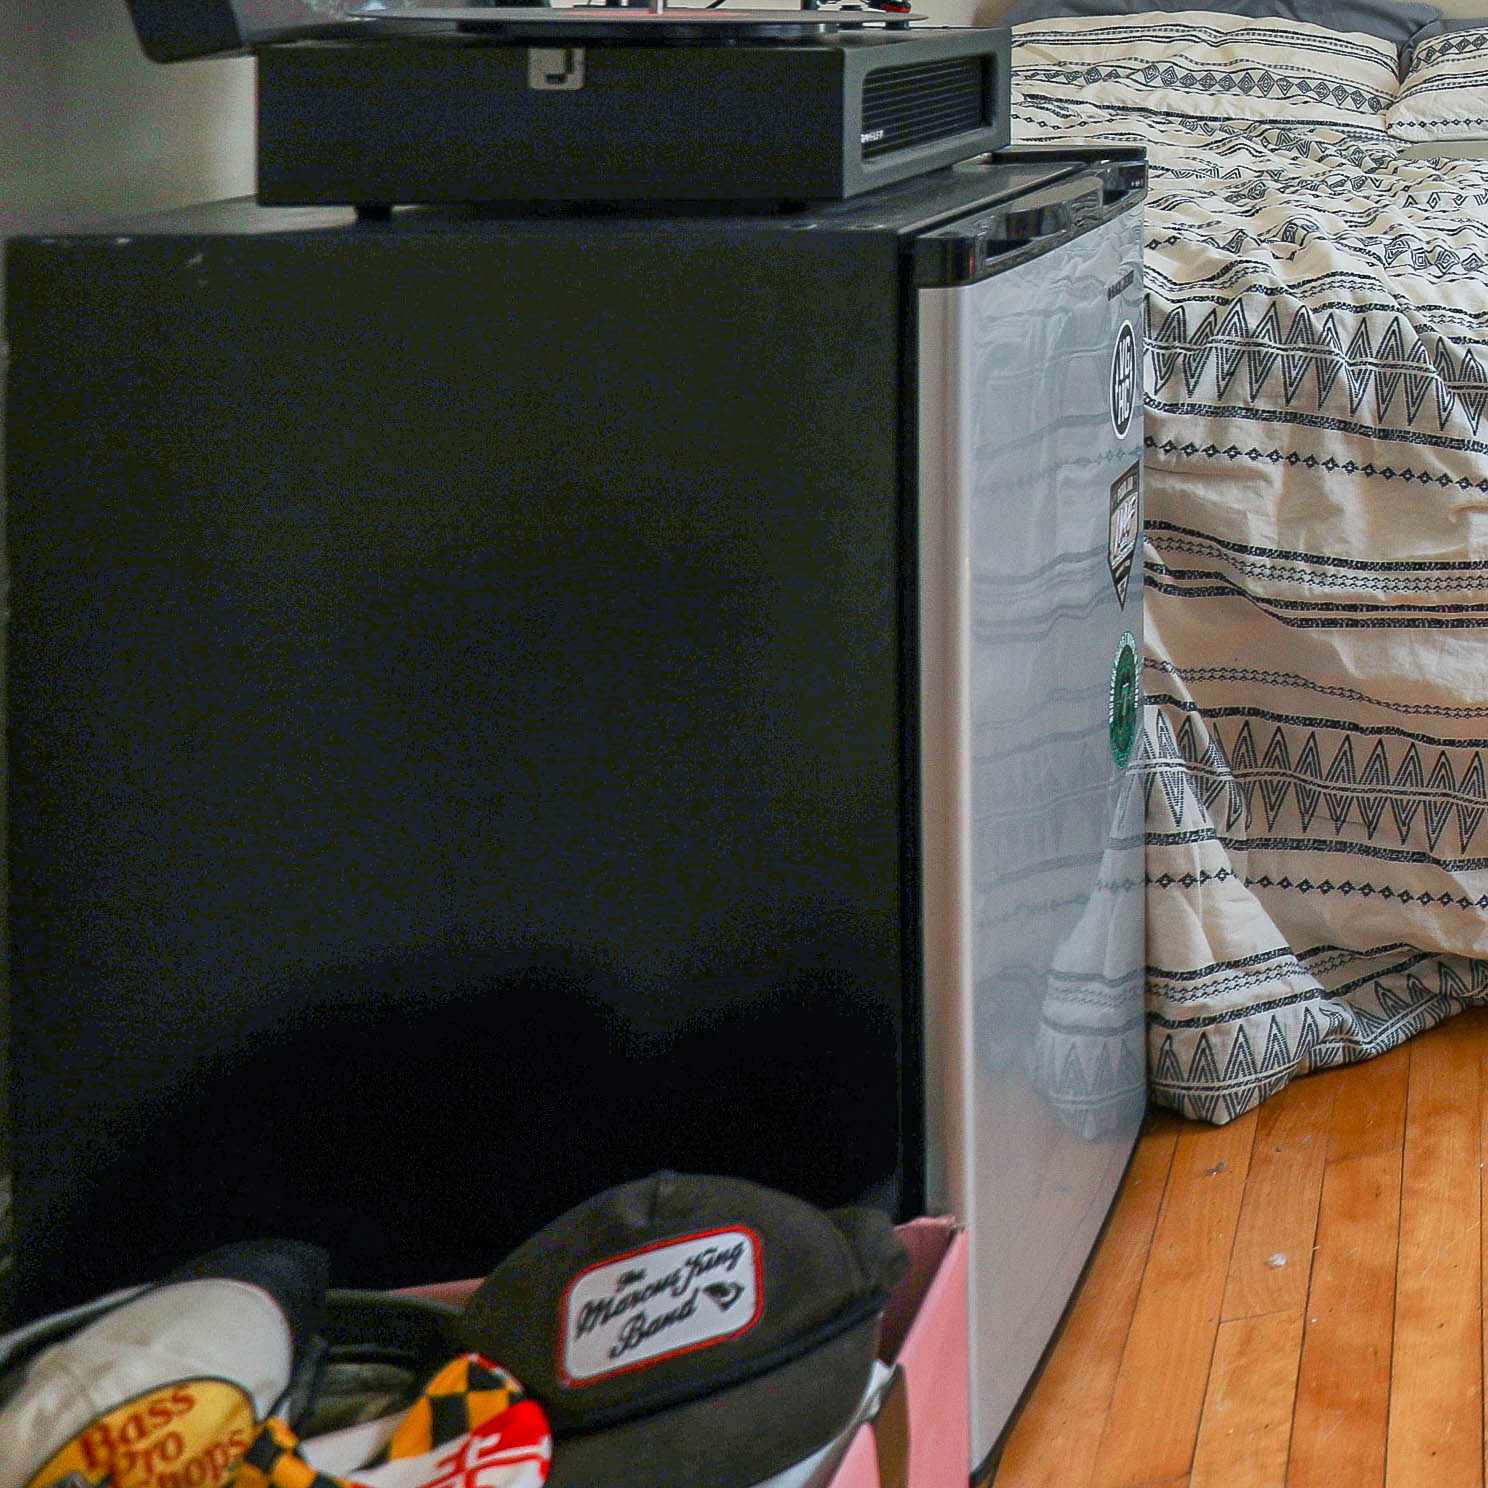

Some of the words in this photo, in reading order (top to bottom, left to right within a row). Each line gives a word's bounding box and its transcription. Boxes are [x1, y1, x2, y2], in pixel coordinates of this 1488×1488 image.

[576, 1268, 684, 1341] Marcus
[671, 1241, 745, 1298] King
[616, 1267, 647, 1293] The
[609, 1288, 700, 1359] Band
[82, 1384, 196, 1470] Bass
